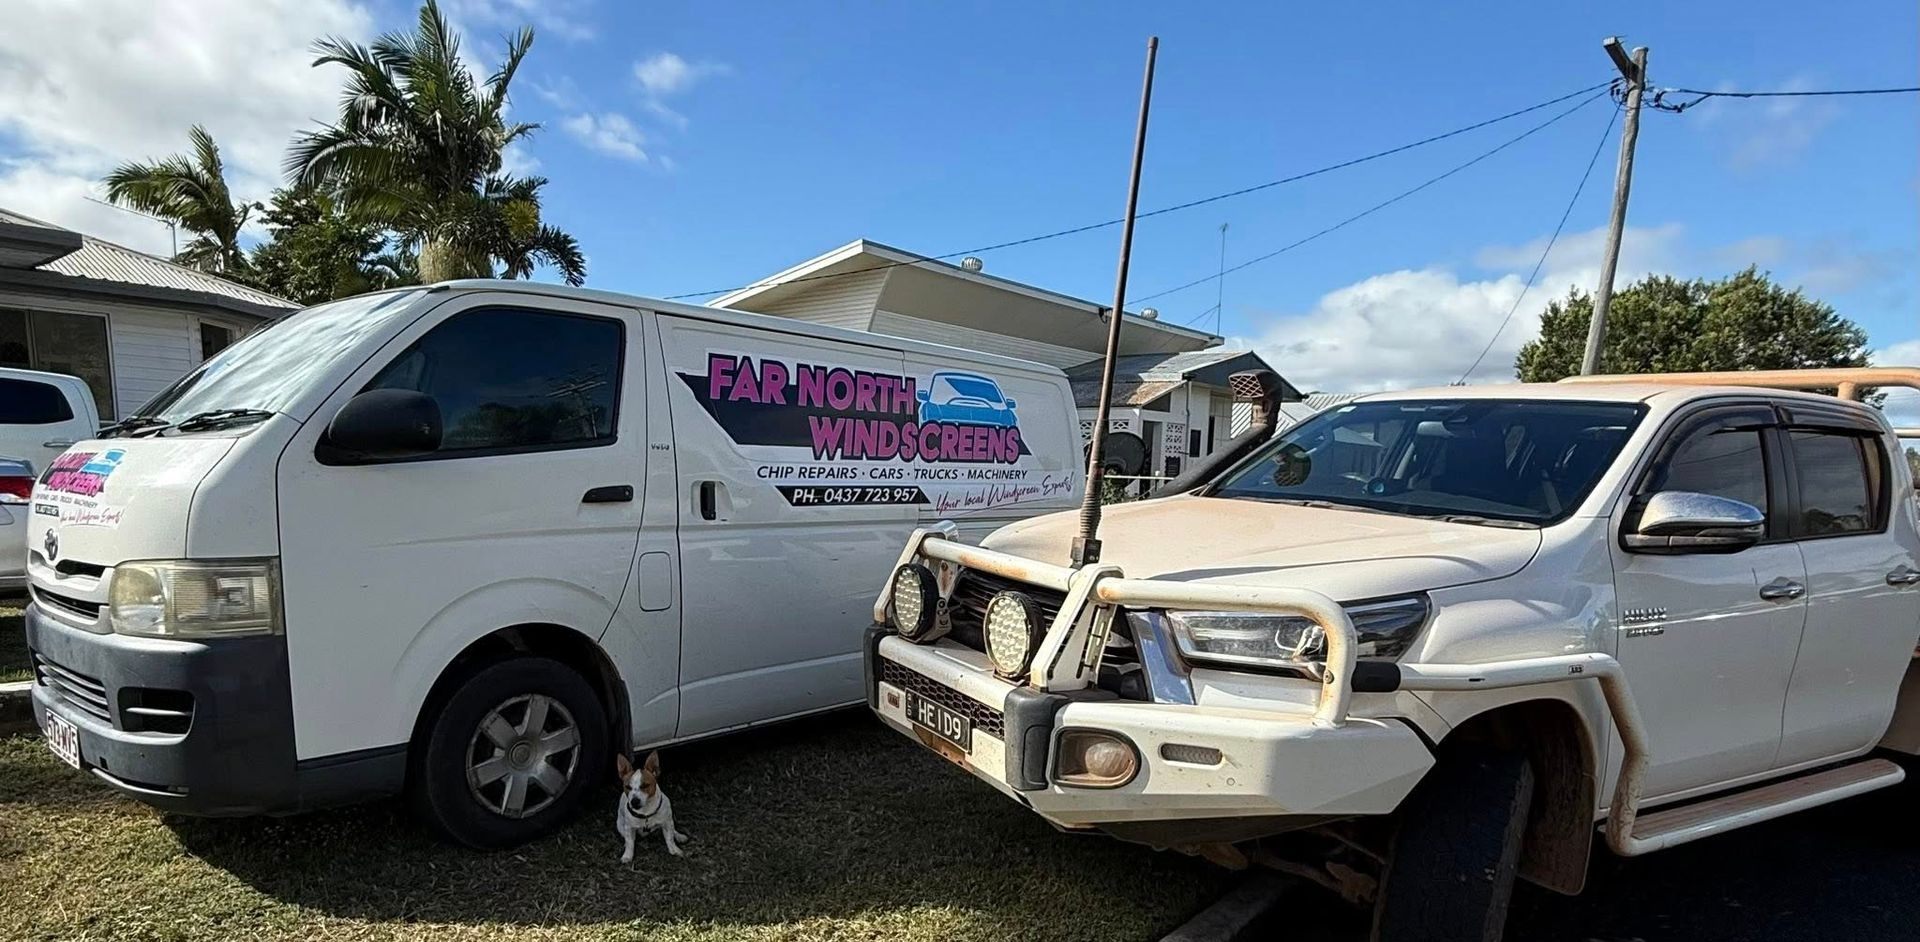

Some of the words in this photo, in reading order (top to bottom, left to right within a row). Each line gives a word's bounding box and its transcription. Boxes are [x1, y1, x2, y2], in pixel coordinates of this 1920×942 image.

[708, 354, 788, 405] FAR
[797, 364, 916, 415] NORTH
[808, 415, 1021, 463] WINDSCREENS
[756, 465, 794, 479] CHIP
[798, 466, 858, 479] REPAIRS
[869, 467, 904, 480] CARS
[914, 468, 958, 480] TRUCKS
[967, 469, 1027, 480] MACHINERY
[792, 487, 818, 503] PH.
[824, 487, 861, 503] 0437
[864, 487, 890, 502] 723
[893, 487, 918, 502] 957
[935, 491, 960, 516] Your
